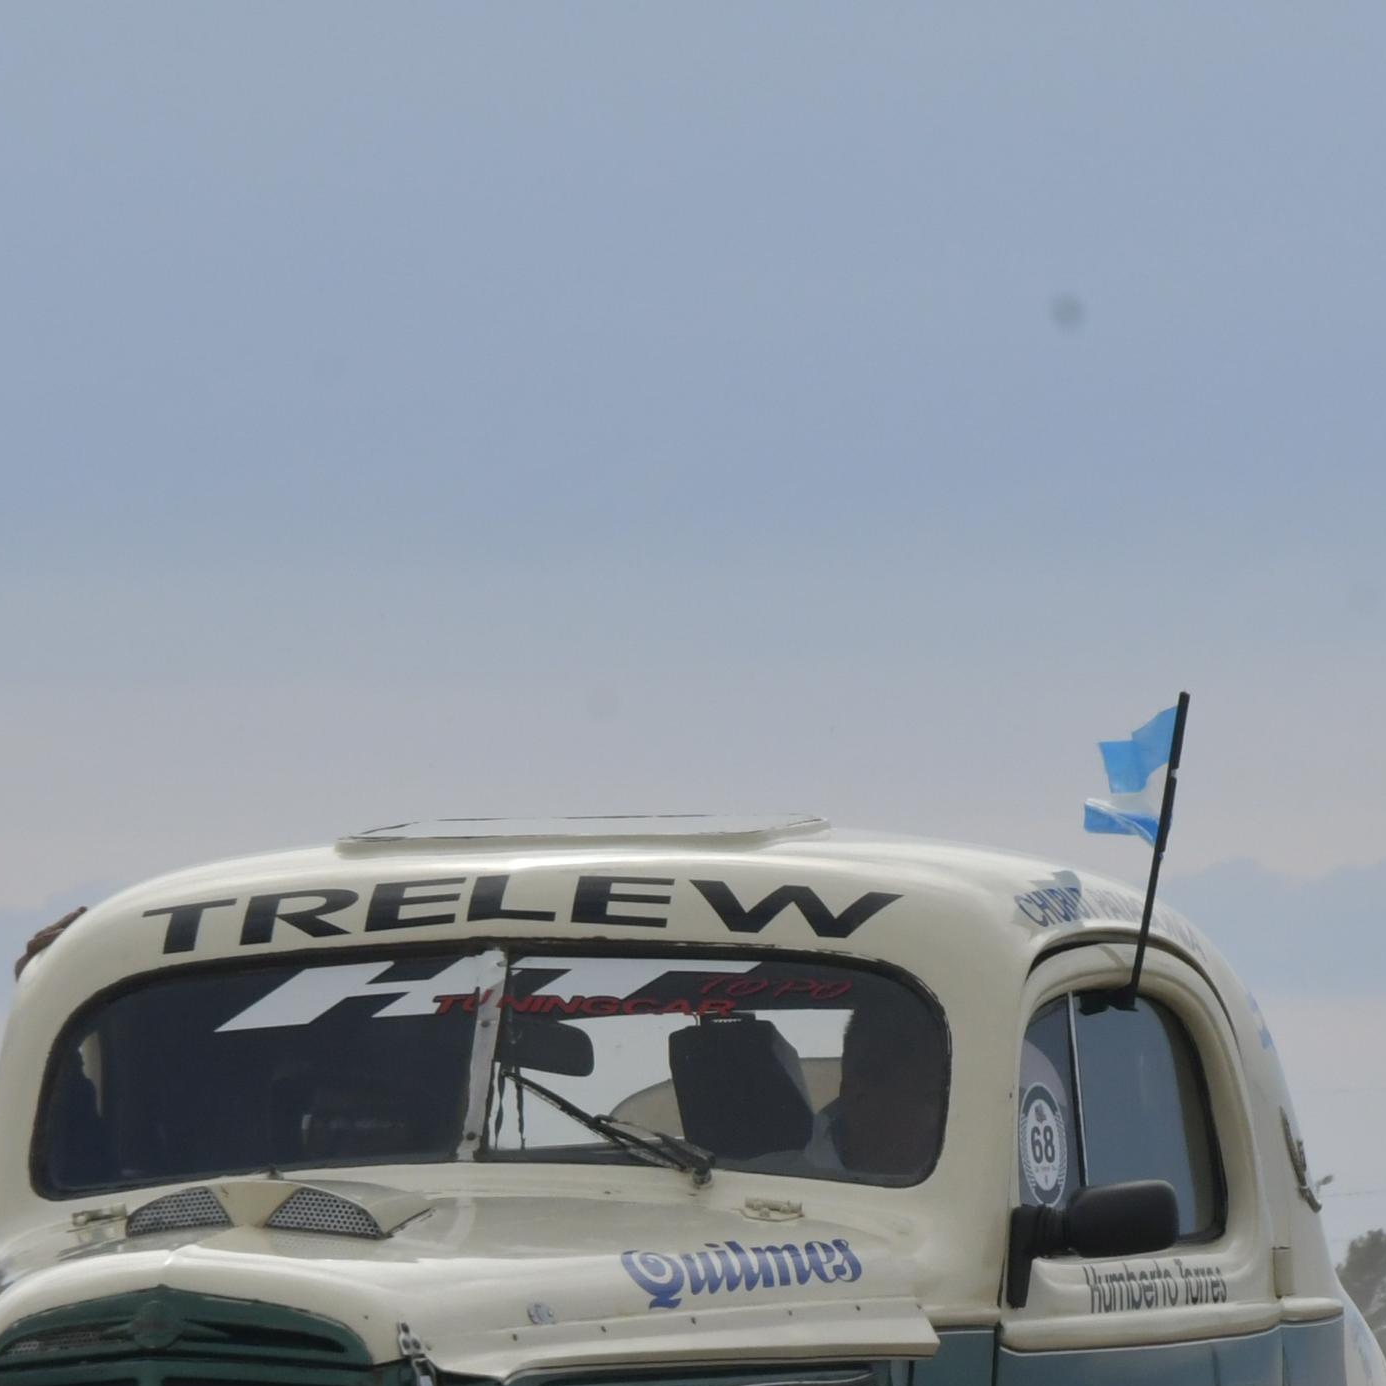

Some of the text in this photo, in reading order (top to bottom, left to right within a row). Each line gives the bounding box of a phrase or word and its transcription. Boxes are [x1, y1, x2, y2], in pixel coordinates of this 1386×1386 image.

[143, 874, 903, 955] TRELEW
[1031, 1125, 1055, 1164] 68
[619, 1238, 862, 1310] Quilmes
[1083, 1258, 1228, 1314] Humberto Torres
